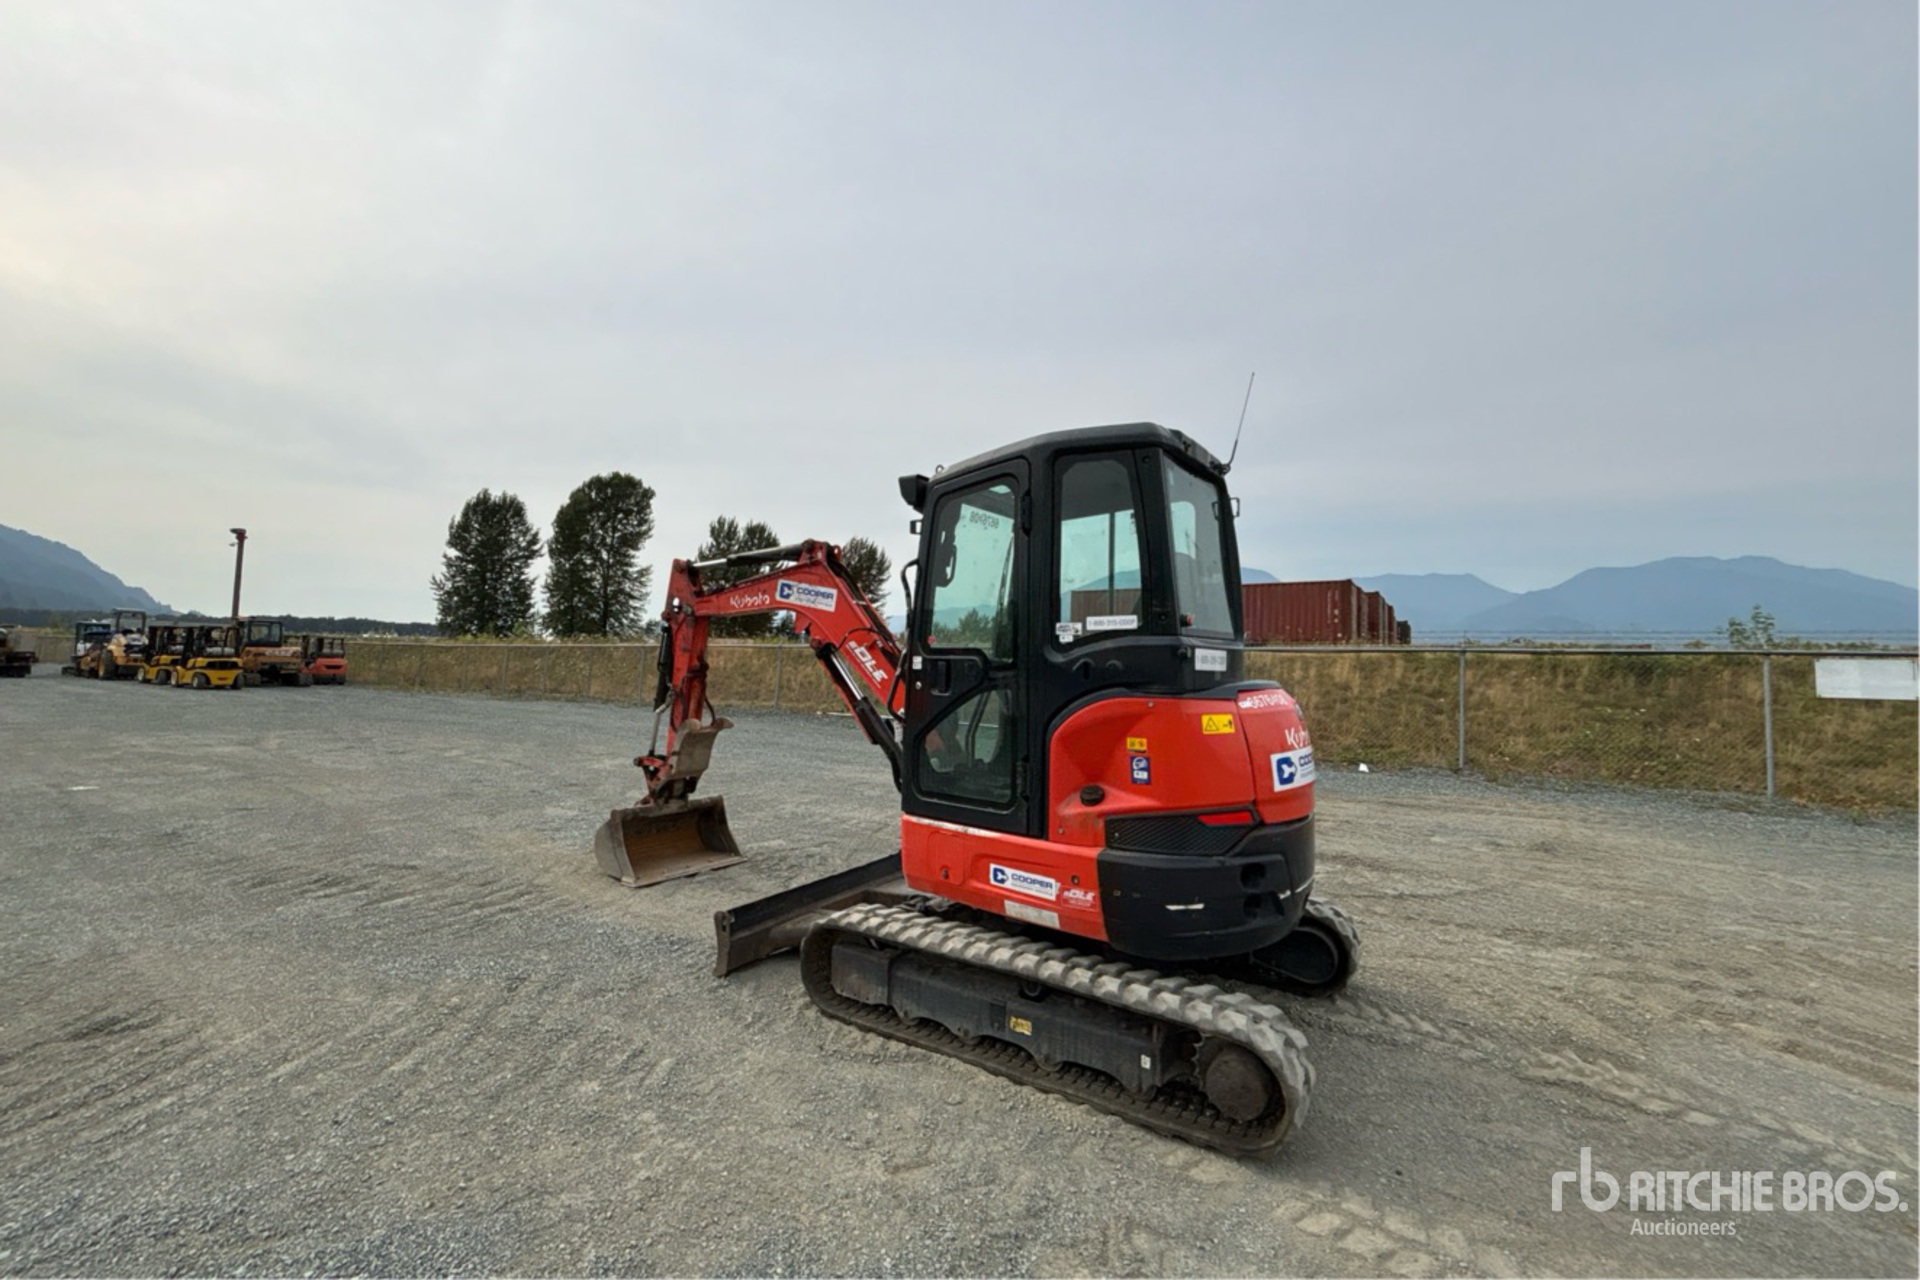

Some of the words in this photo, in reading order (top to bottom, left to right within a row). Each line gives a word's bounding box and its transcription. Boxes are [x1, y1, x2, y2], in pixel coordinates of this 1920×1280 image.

[730, 592, 770, 609] Kubota
[796, 587, 834, 601] COOPER
[1010, 872, 1053, 890] COOPER
